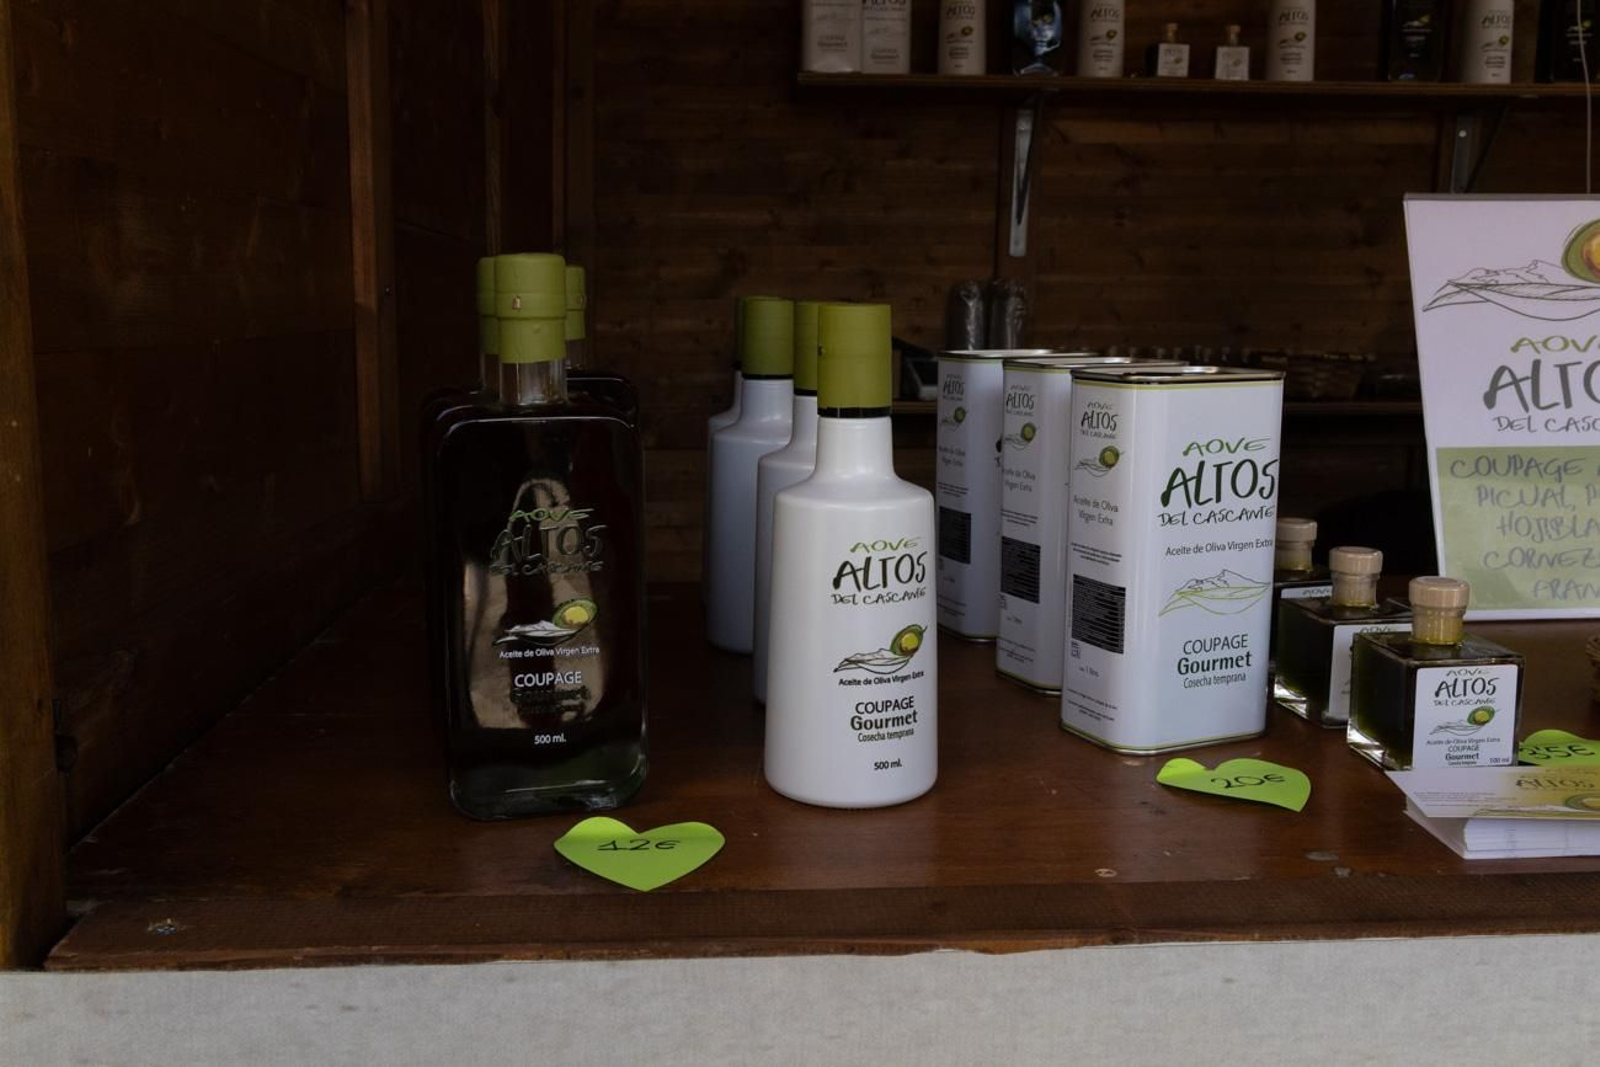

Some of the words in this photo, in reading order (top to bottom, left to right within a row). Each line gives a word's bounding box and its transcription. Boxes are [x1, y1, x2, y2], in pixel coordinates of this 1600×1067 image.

[1510, 335, 1600, 354] AOV
[1006, 392, 1036, 411] ALTOS
[1081, 410, 1119, 431] ALTOS
[1493, 415, 1537, 433] DEL
[1182, 437, 1271, 457] AOVE
[1450, 453, 1586, 483] COUPAGE
[1160, 458, 1279, 509] ALTOS
[510, 507, 595, 522] AOVE
[1101, 500, 1119, 513] Oliva
[1157, 511, 1189, 527] DEL
[1193, 505, 1275, 525] CASCANTE
[489, 523, 609, 563] ALTOS
[849, 537, 922, 554] AOVE
[1165, 545, 1192, 557] Aceite
[1193, 543, 1204, 554] de
[1205, 541, 1227, 553] Oliva
[1227, 539, 1254, 553] Virgen
[1255, 537, 1274, 549] Extra
[832, 551, 928, 592] ALTOS
[830, 592, 858, 606] DEL
[499, 650, 522, 660] Aceite
[523, 650, 534, 658] de
[535, 648, 555, 658] Oliva
[556, 646, 580, 658] Virgen
[581, 645, 600, 655] Extra
[1182, 633, 1249, 656] COUPAGE
[1177, 650, 1252, 676] Gourmet
[514, 671, 582, 688] COUPAGE
[838, 678, 861, 688] Aceite
[862, 677, 872, 686] de
[873, 675, 891, 685] Oliva
[892, 673, 911, 685] Virgen
[1183, 676, 1212, 690] Cosecha
[1213, 672, 1247, 688] temprana
[1434, 677, 1500, 700] ALTOS
[855, 695, 915, 715] COUPAGE
[850, 709, 918, 732] Gourmet
[533, 733, 551, 745] 500
[857, 731, 886, 744] Cosecha
[886, 727, 914, 741] temprana
[1445, 753, 1479, 761] Gourmet
[1448, 744, 1479, 753] COUPAGE
[873, 760, 890, 771] 500
[597, 838, 681, 851] 12€
